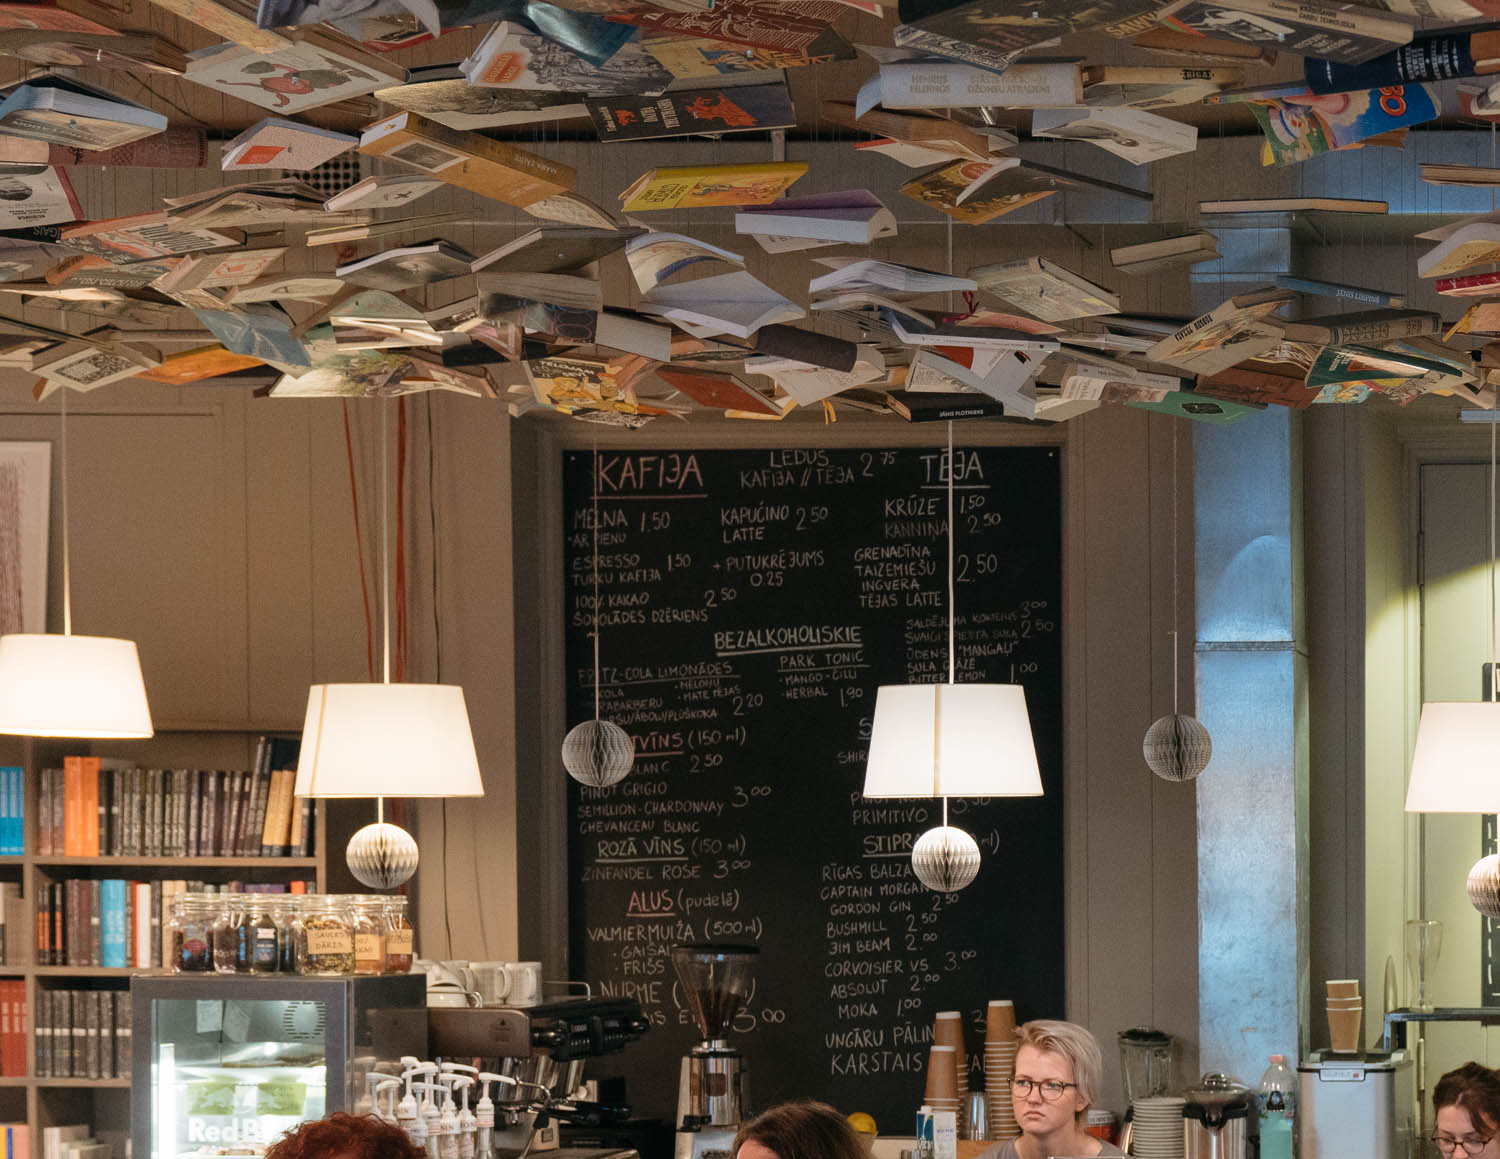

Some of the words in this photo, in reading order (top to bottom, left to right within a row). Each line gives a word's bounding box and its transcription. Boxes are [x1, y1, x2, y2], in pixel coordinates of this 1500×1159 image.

[598, 453, 704, 492] KAFIJA
[770, 449, 830, 468] LEDUS
[919, 448, 984, 483] TĒJA
[740, 471, 795, 489] KAFIJA
[816, 464, 855, 485] TĒJA
[884, 494, 941, 517] KRŪZE
[723, 526, 766, 544] LATTE
[749, 571, 784, 587] 0.25
[608, 592, 650, 607] KAKAO
[905, 591, 943, 607] LATTE
[714, 625, 864, 650] BEZALKOHOLISKIE
[779, 654, 816, 668] PARK
[824, 652, 864, 666] TONIC
[578, 665, 652, 685] FRTZ-COLA
[907, 661, 937, 675] SULA
[942, 658, 976, 672] GĀZĒ
[952, 670, 987, 683] EMON
[785, 685, 829, 700] HERBAL
[622, 781, 668, 797] GRIGIO
[851, 807, 929, 826] PRIMITIVO
[663, 821, 701, 833] BLANC
[642, 836, 685, 855] VĪNS
[821, 862, 864, 882] RĪGAS
[869, 862, 913, 880] BALZA
[627, 888, 675, 913] ALUS
[820, 885, 873, 901] CAPTAIN
[830, 901, 881, 917] GORDON
[889, 899, 912, 913] GIN
[825, 920, 888, 939] BUSHMILL
[620, 942, 678, 960] GAIŠAI
[856, 936, 892, 954] BEAM
[829, 978, 888, 1000] ABSOLUT
[837, 1001, 879, 1021] MOKA
[892, 1020, 935, 1044] PĀLIN
[830, 1051, 923, 1076] KARSTAIS
[188, 1117, 233, 1143] Red
